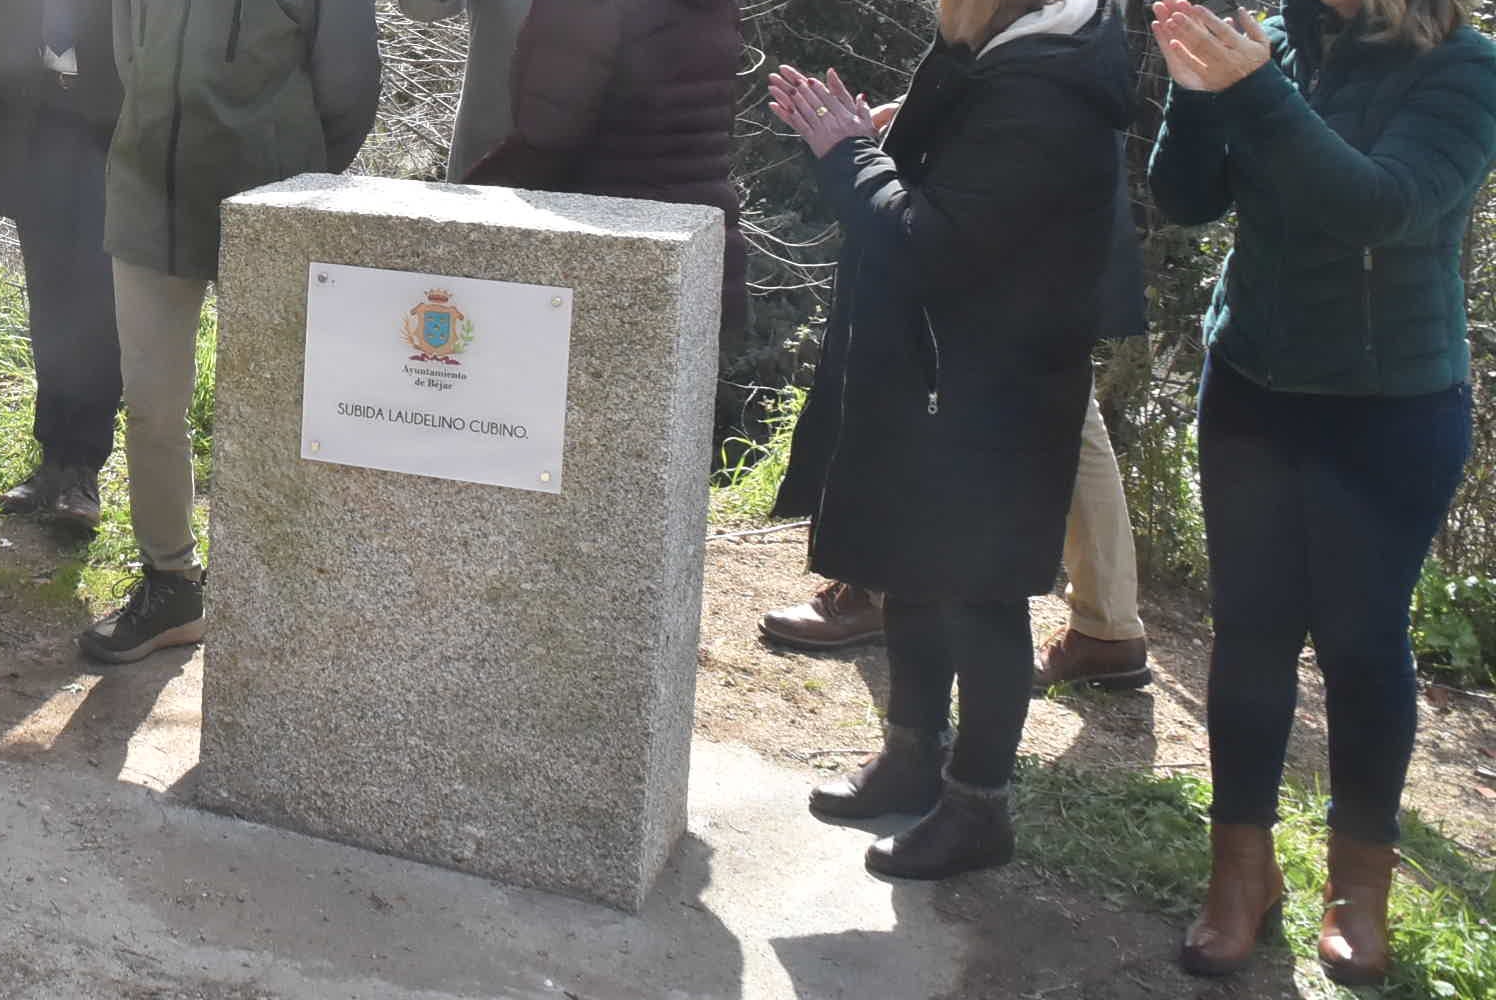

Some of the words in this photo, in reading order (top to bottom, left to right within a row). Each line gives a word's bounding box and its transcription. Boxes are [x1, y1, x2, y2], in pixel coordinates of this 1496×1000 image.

[402, 365, 467, 380] Ayuntamiento
[414, 377, 425, 386] de
[337, 402, 385, 420] SUBIDA
[388, 409, 465, 431] LAUDELINO
